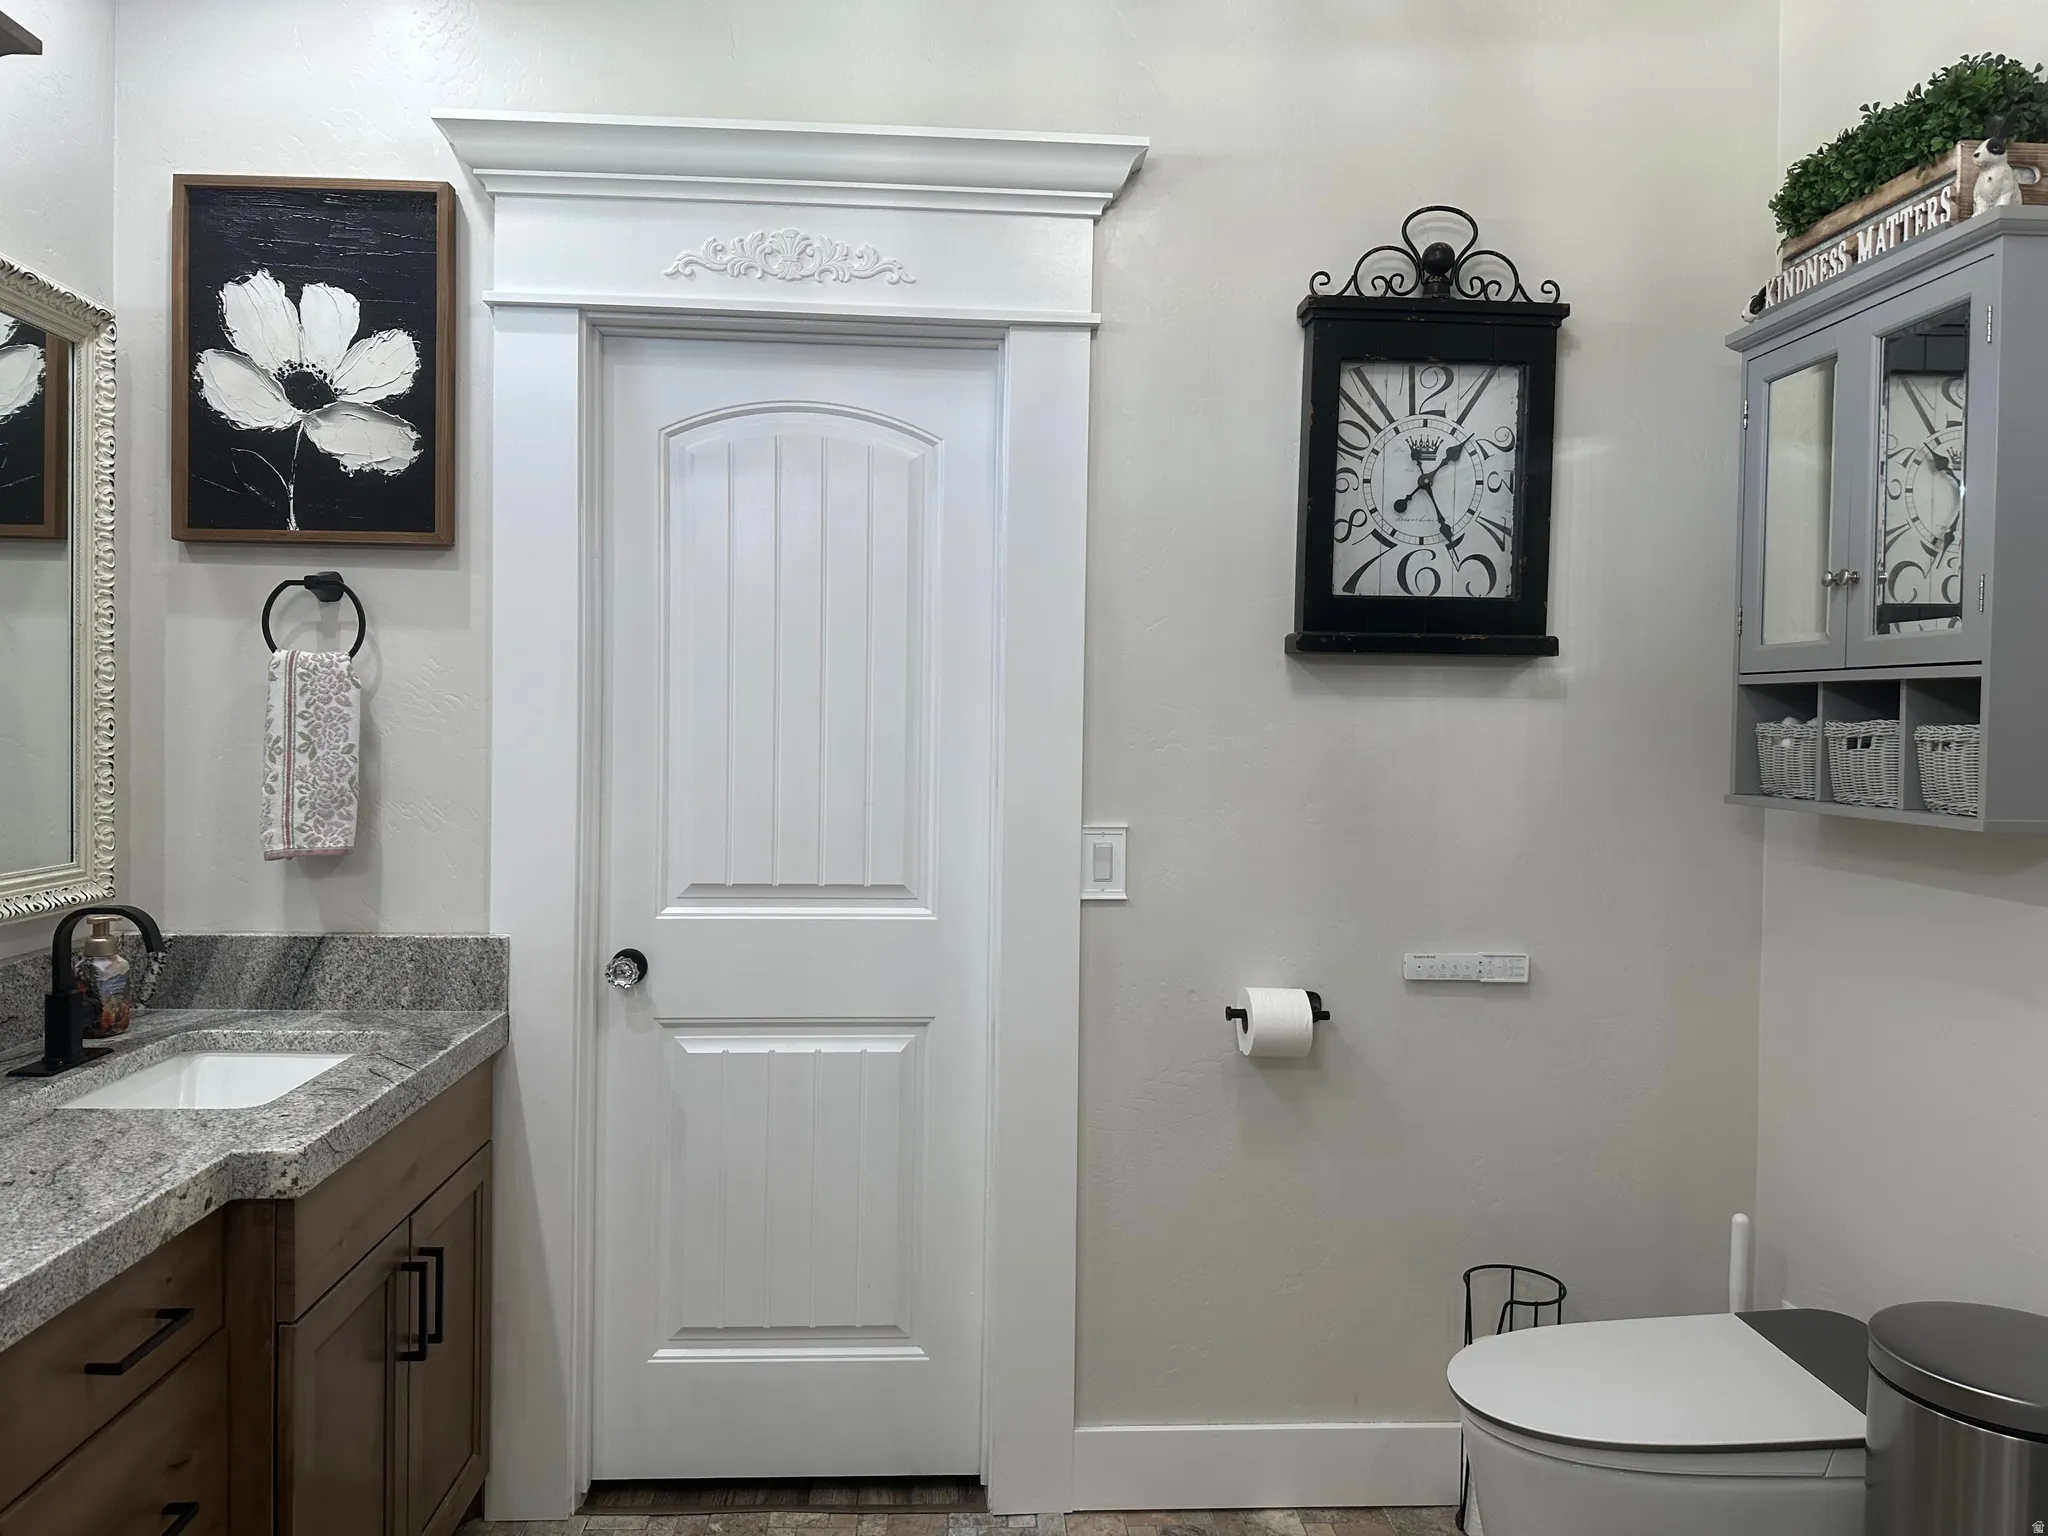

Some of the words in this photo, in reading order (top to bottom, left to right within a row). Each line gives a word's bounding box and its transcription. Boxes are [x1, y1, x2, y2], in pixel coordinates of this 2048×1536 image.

[1765, 241, 1848, 308] KINDNESS
[1857, 186, 1952, 264] MATTERS
[1399, 365, 1453, 418] 12
[1452, 366, 1499, 428] 1
[1336, 420, 1371, 463] 10
[1476, 426, 1515, 461] 2
[1335, 467, 1359, 493] 9
[1487, 470, 1514, 494] 3
[1334, 508, 1367, 543] 8
[1475, 511, 1512, 553] 4
[1342, 529, 1398, 594] 7
[1397, 549, 1440, 596] 6
[1445, 533, 1497, 597] 5
